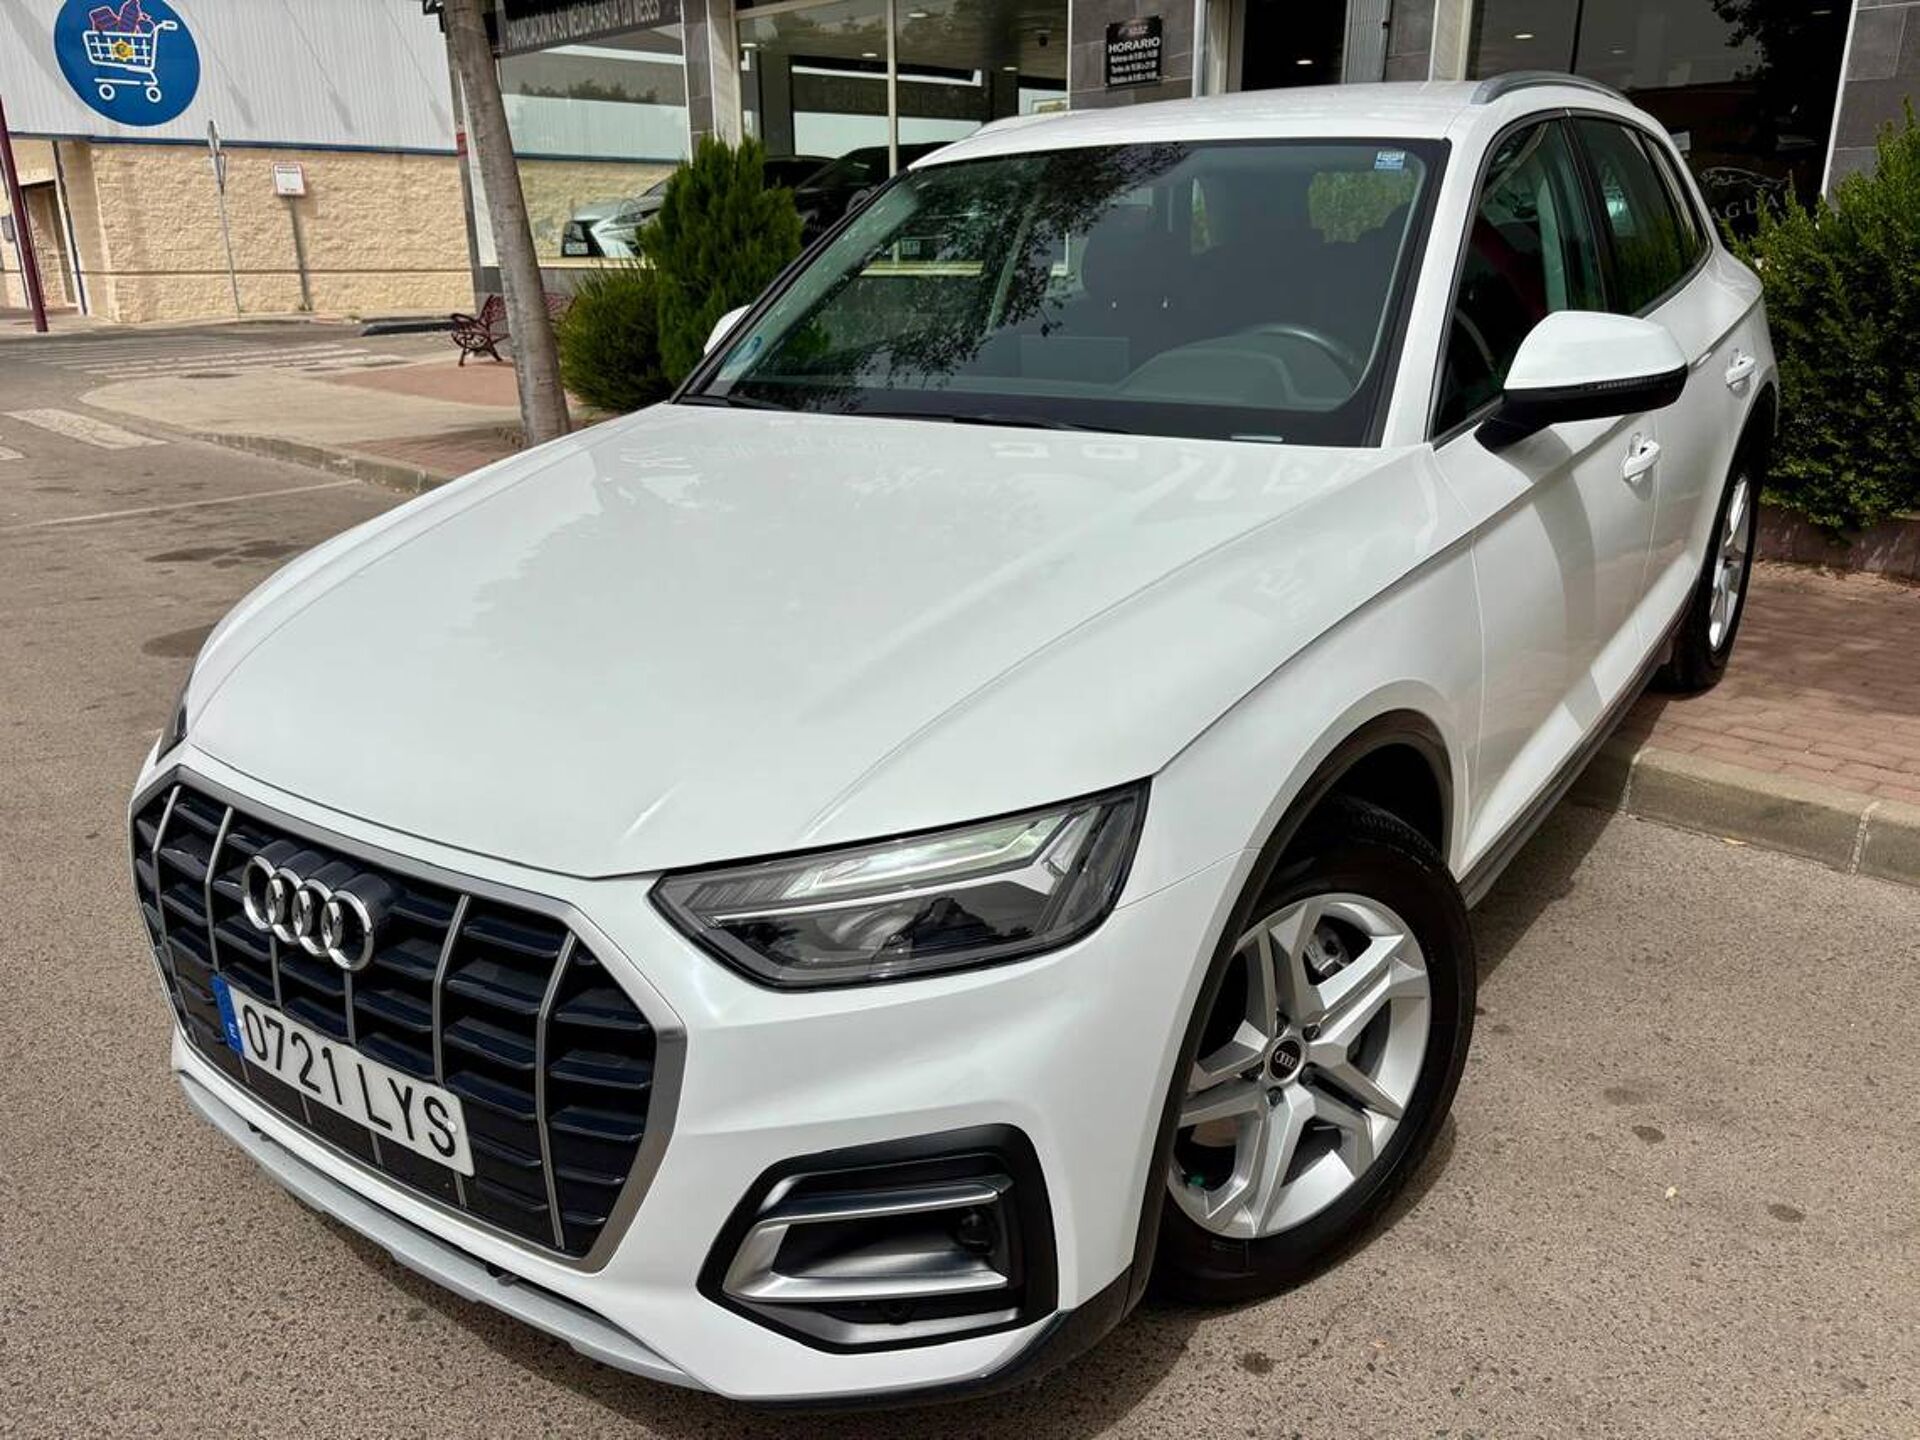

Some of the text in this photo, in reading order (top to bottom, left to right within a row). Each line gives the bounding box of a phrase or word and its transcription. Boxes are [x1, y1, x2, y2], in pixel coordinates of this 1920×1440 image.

[1108, 37, 1160, 53] HORARIO
[242, 1004, 456, 1158] 0721 LYS
